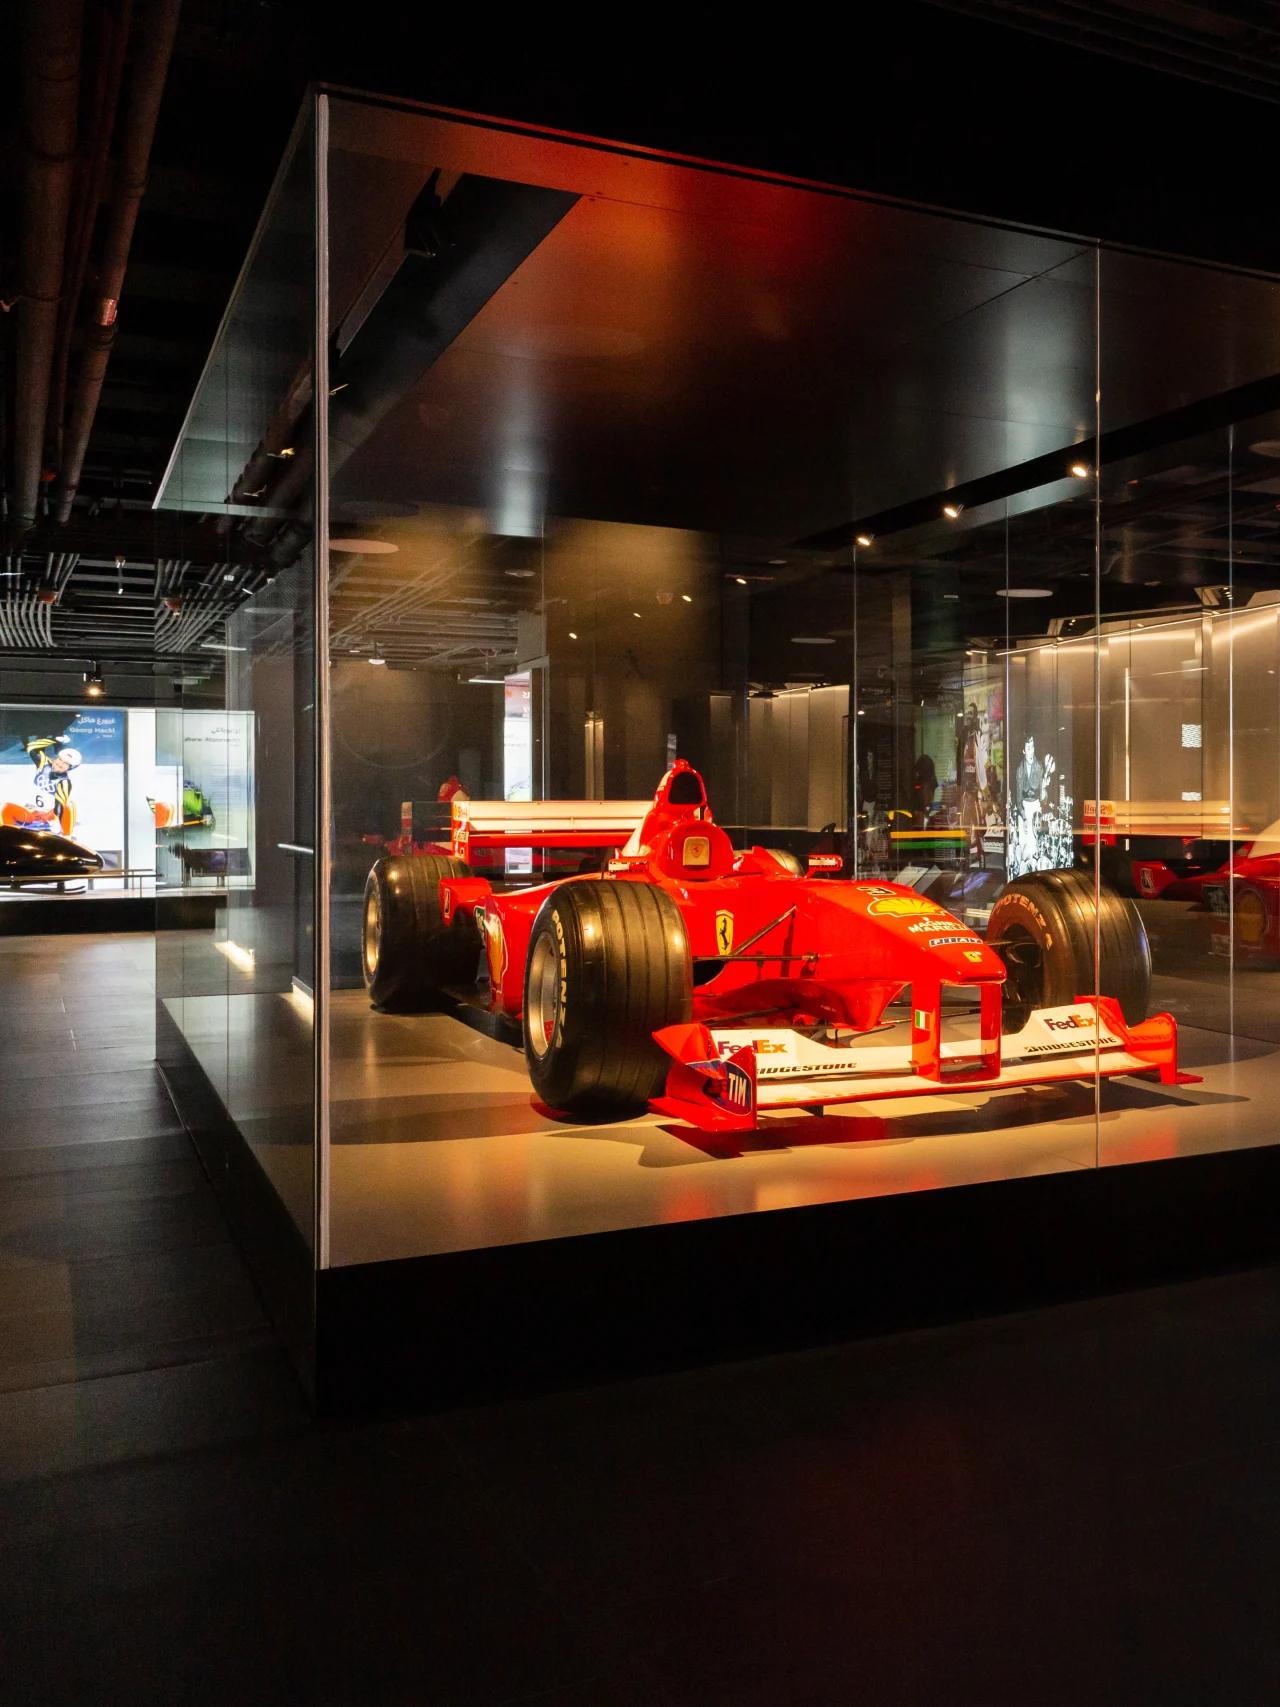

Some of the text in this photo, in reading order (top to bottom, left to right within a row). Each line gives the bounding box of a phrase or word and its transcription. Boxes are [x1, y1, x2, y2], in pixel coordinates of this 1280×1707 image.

[35, 794, 44, 808] 6
[1043, 1014, 1096, 1032] FedEx
[717, 1038, 788, 1055] FedEx
[756, 1062, 858, 1075] IDGESTONE
[728, 1072, 748, 1108] TIM
